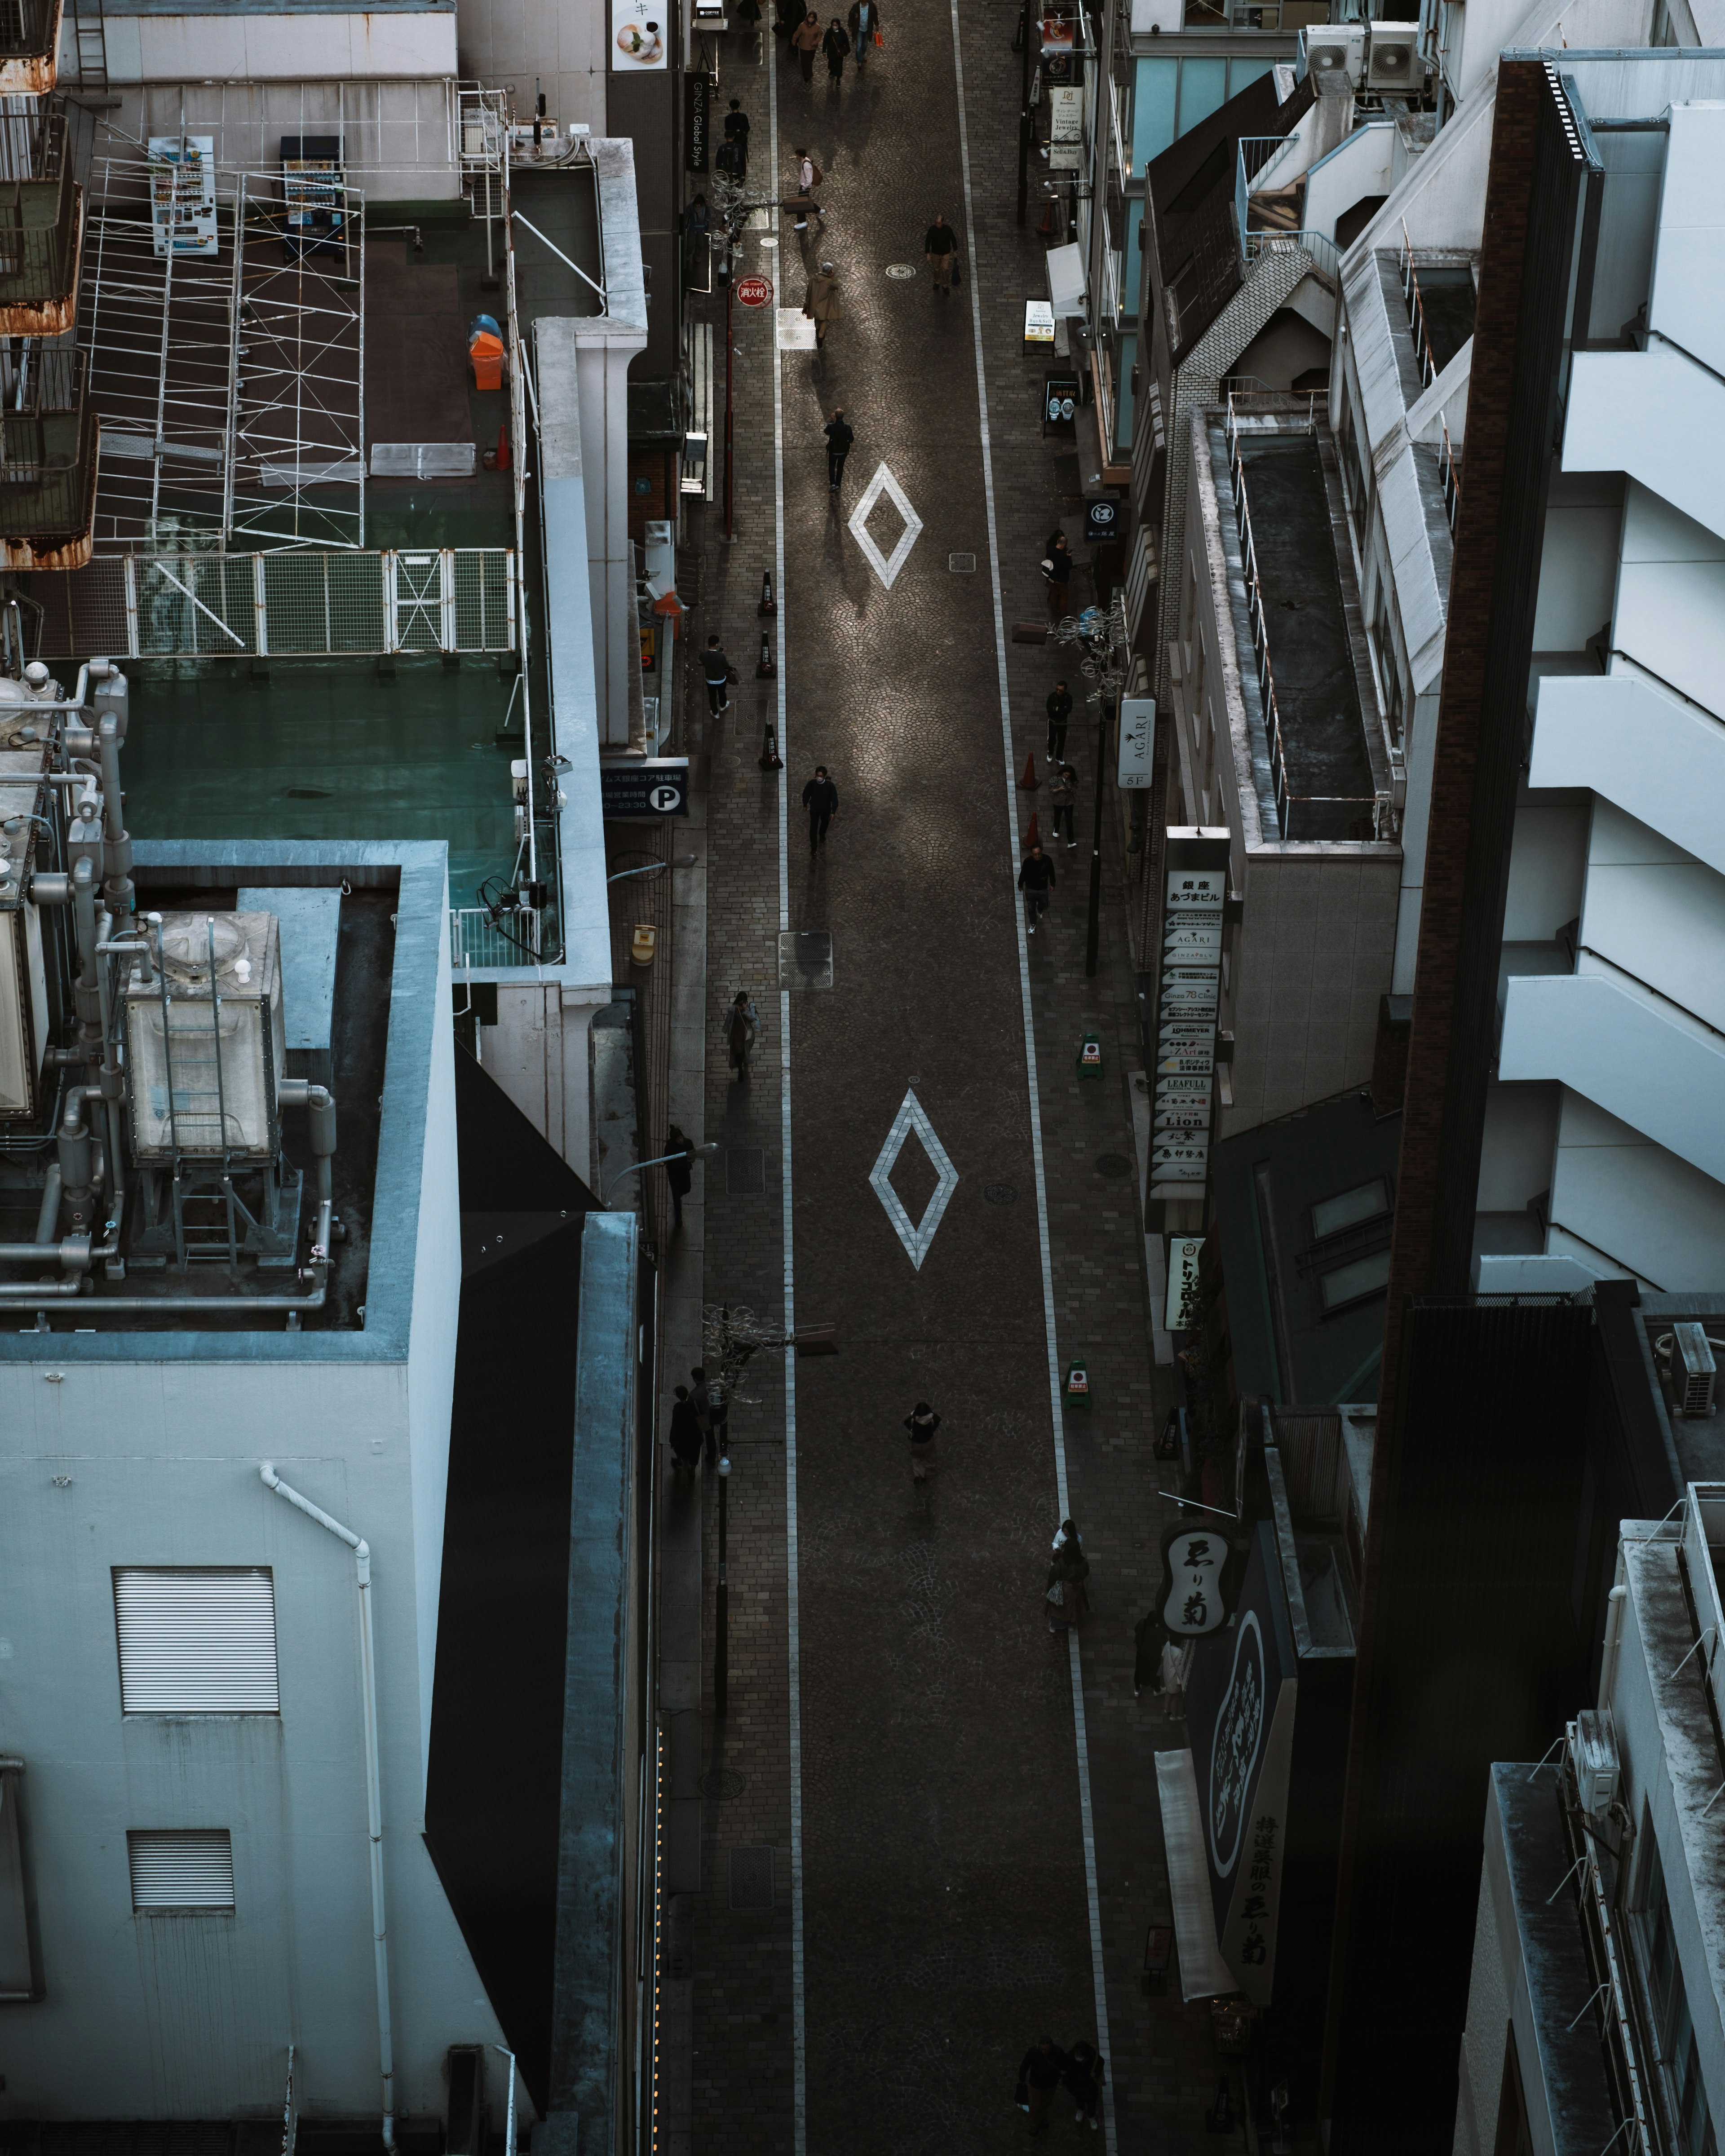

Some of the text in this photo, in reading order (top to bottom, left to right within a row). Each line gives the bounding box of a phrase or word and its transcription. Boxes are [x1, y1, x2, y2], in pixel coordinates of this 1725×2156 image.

[635, 0, 648, 15] キ
[691, 82, 703, 166] GINZA Global Style
[741, 287, 765, 297] 消火栓
[1134, 716, 1148, 759] AGARI
[1127, 777, 1143, 785] 5F
[658, 789, 676, 808] P
[1182, 881, 1210, 890] 銀座
[1171, 892, 1220, 901] あづまビル
[1165, 1117, 1203, 1126] Lion
